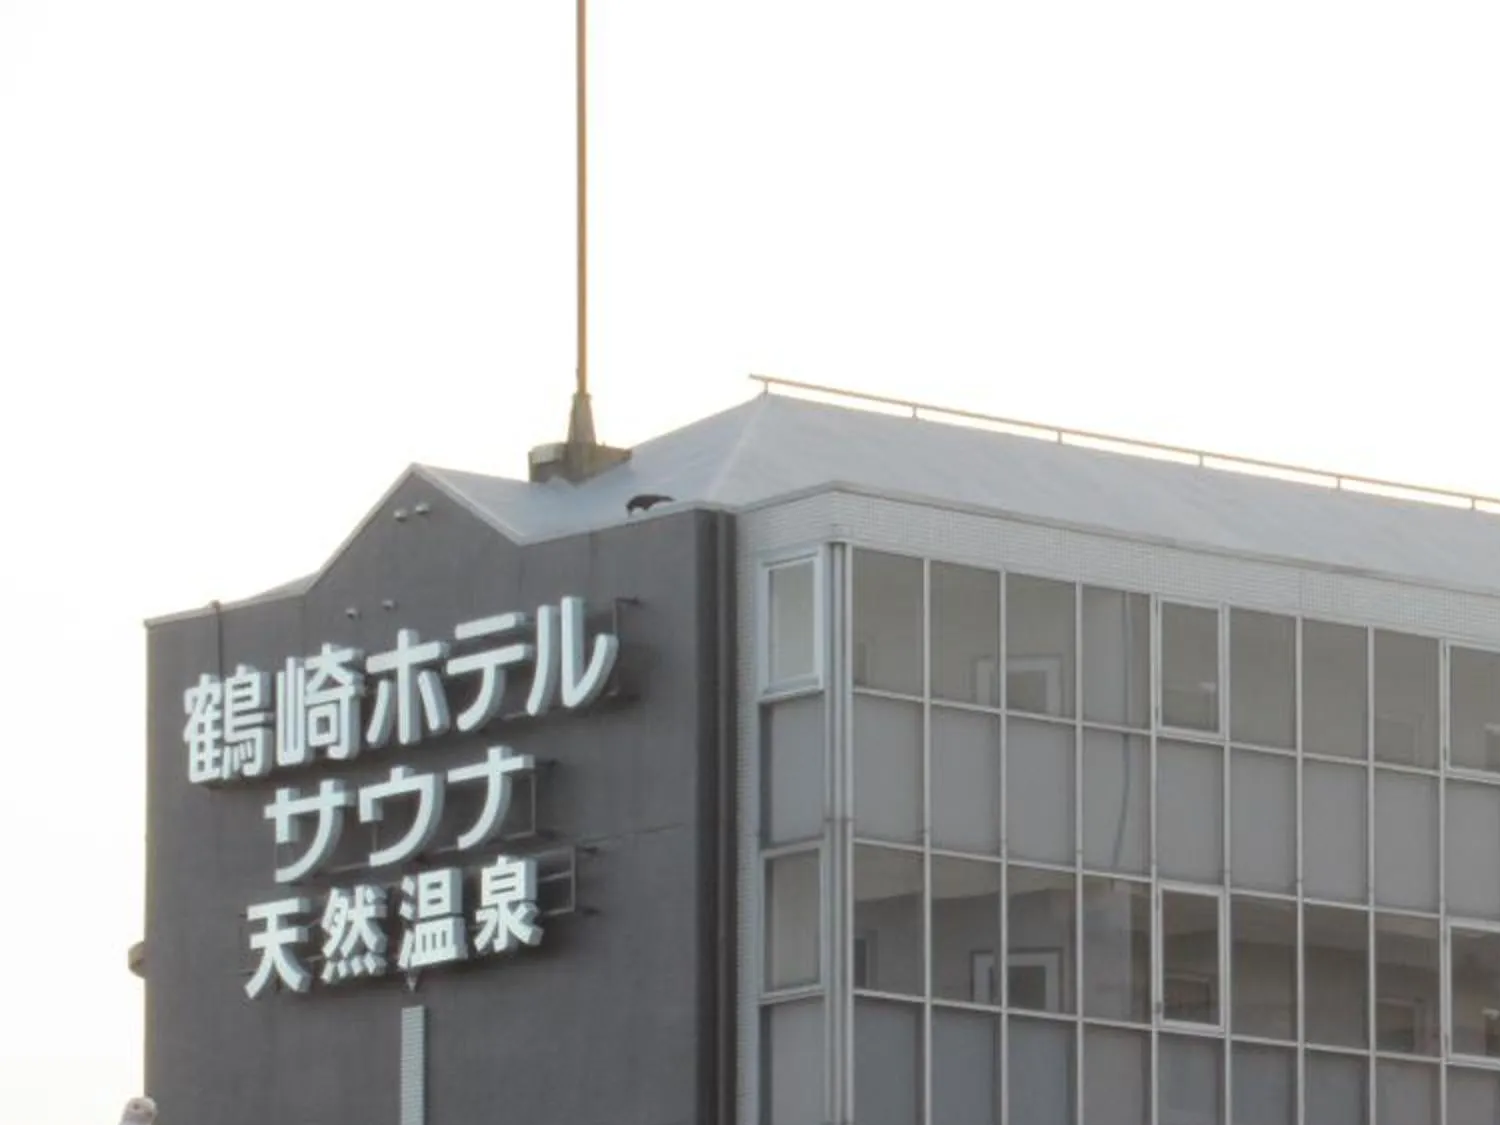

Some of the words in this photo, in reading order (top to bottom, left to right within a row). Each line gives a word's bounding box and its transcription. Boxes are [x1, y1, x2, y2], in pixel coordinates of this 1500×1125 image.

[184, 596, 619, 784] 鶴崎ホテル
[264, 746, 534, 883] サウナ
[245, 856, 544, 1000] 天然温泉
